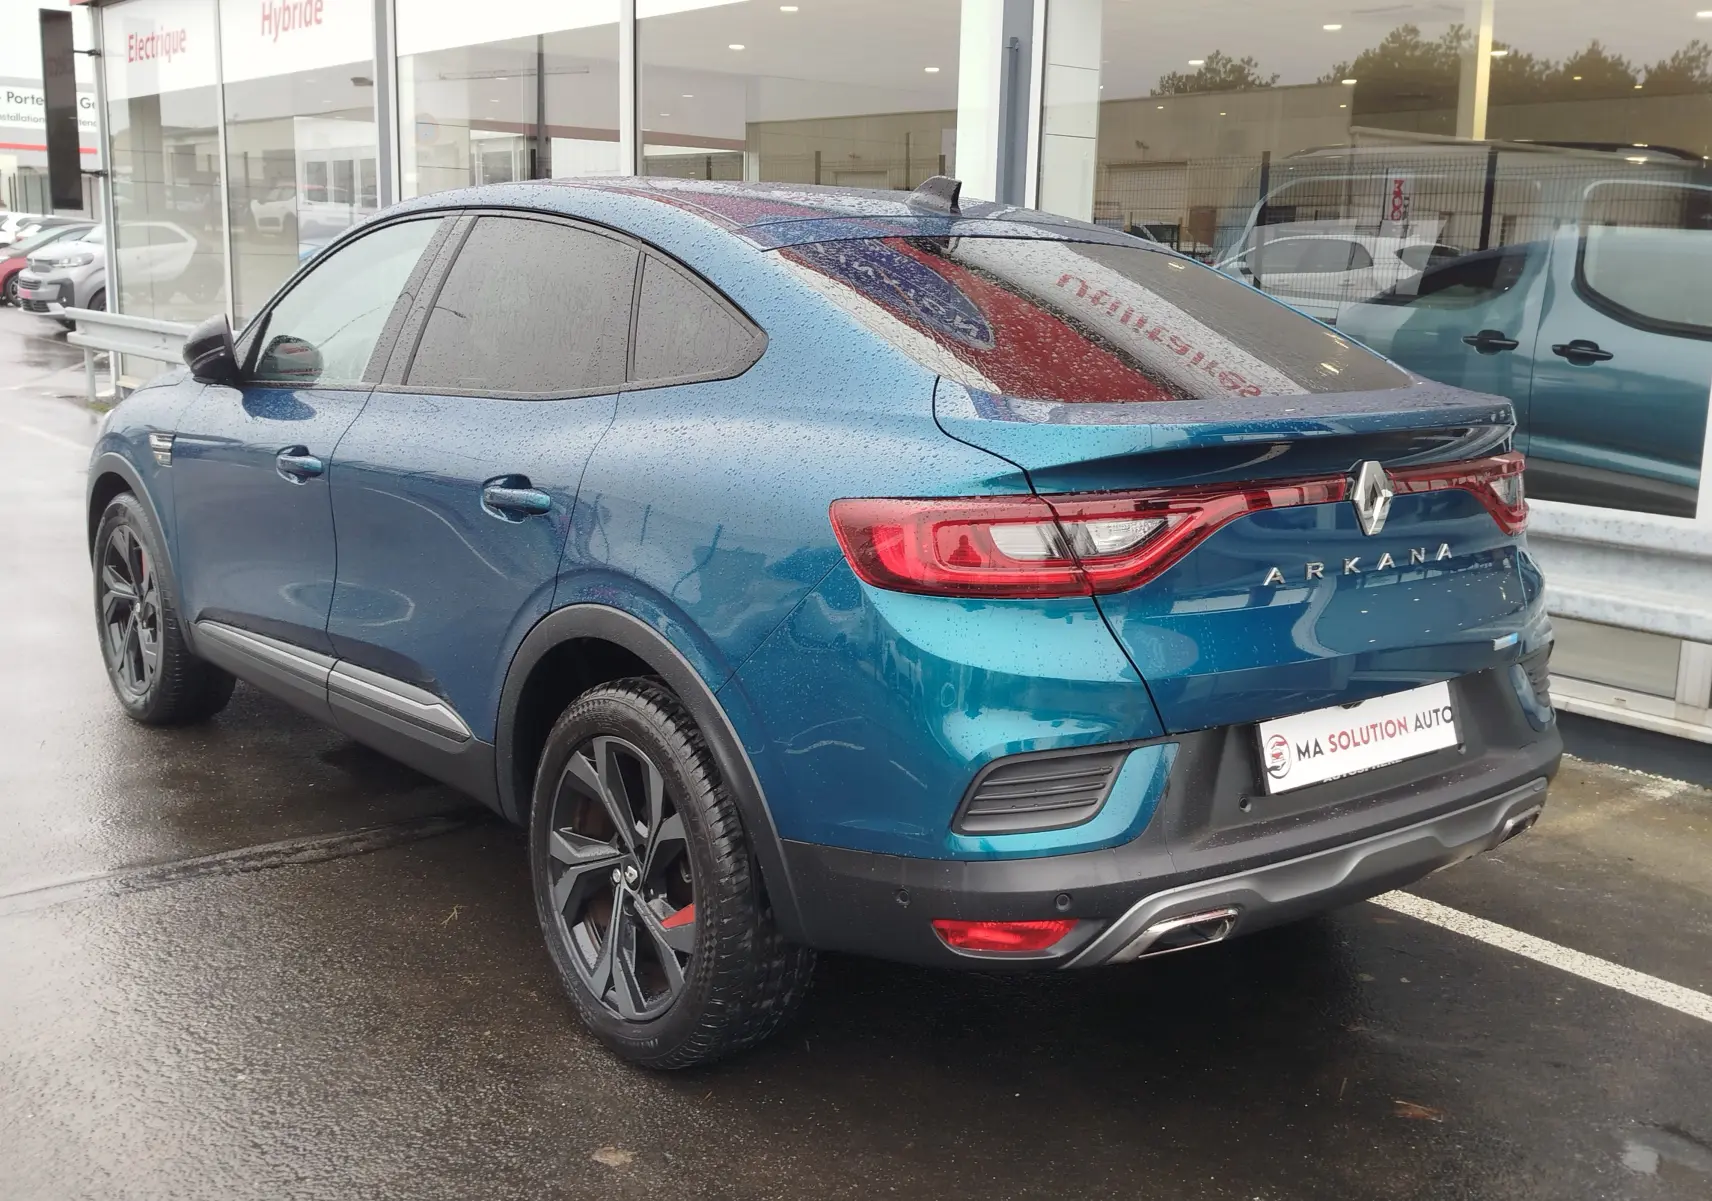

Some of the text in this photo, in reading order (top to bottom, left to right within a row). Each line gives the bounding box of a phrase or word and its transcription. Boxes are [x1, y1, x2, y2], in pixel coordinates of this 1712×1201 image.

[261, 0, 324, 43] Hybride
[128, 26, 187, 63] Electrique
[1263, 543, 1452, 586] ARKANA
[1296, 705, 1453, 762] MA SOLUTION AUTO
